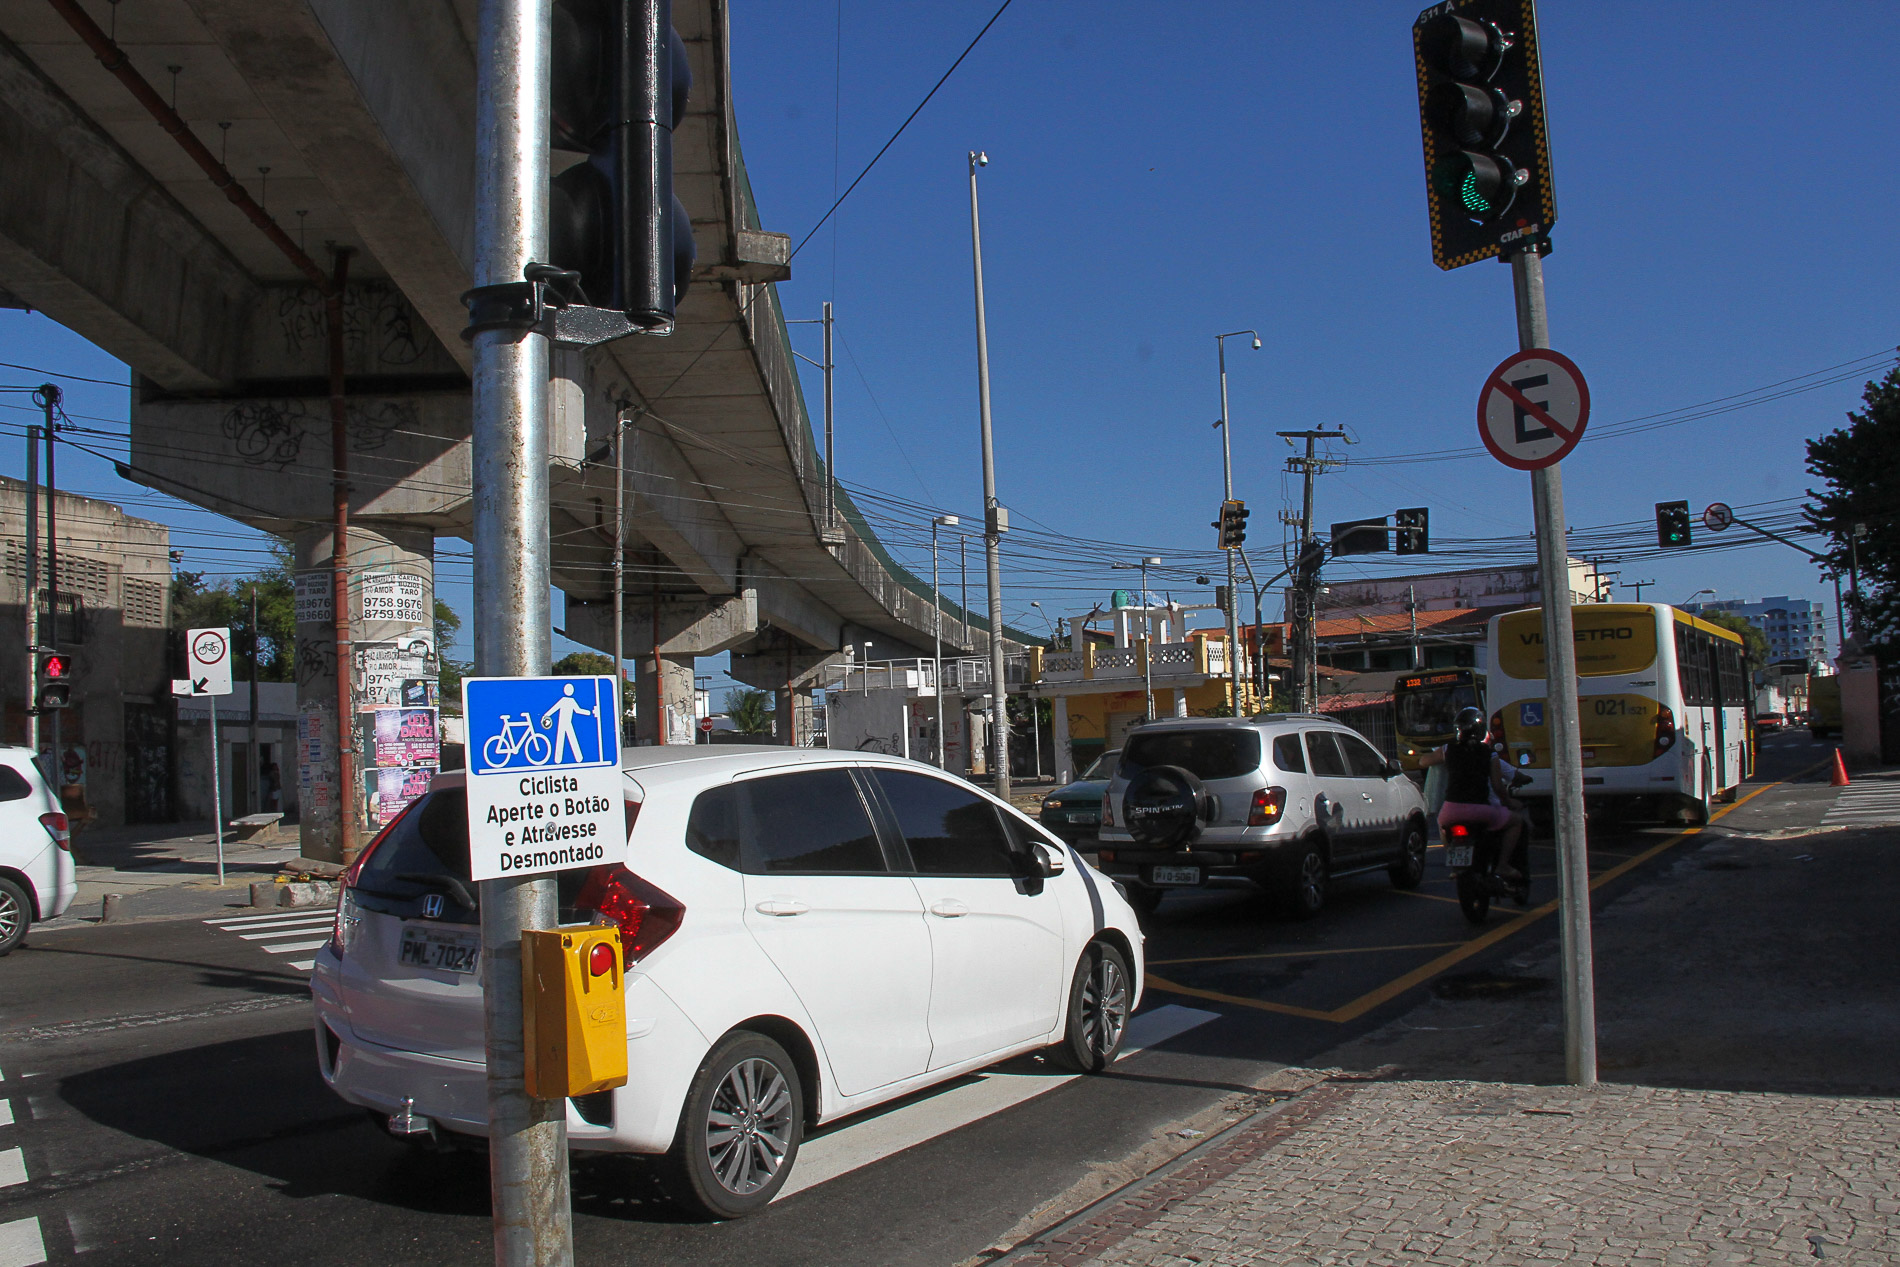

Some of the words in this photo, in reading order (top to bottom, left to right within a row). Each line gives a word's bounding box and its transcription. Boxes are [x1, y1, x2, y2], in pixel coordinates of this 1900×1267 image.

[1420, 7, 1439, 23] 511
[1444, 0, 1455, 14] A
[363, 597, 422, 610] 9758.9676
[364, 609, 422, 621] 8759.9660
[1519, 632, 1545, 645] VI
[1573, 627, 1633, 642] ETRO
[378, 662, 398, 670] AMOR
[1594, 699, 1626, 716] 021
[407, 713, 430, 726] LET'S
[400, 725, 433, 738] DANCE
[519, 775, 578, 796] Ciclista
[486, 802, 544, 828] Aperte
[549, 803, 560, 818] o
[564, 795, 610, 816] Botão
[1135, 806, 1160, 814] SPIN
[504, 831, 515, 847] e
[521, 821, 597, 845] Atravesse
[500, 842, 604, 872] Desmontado
